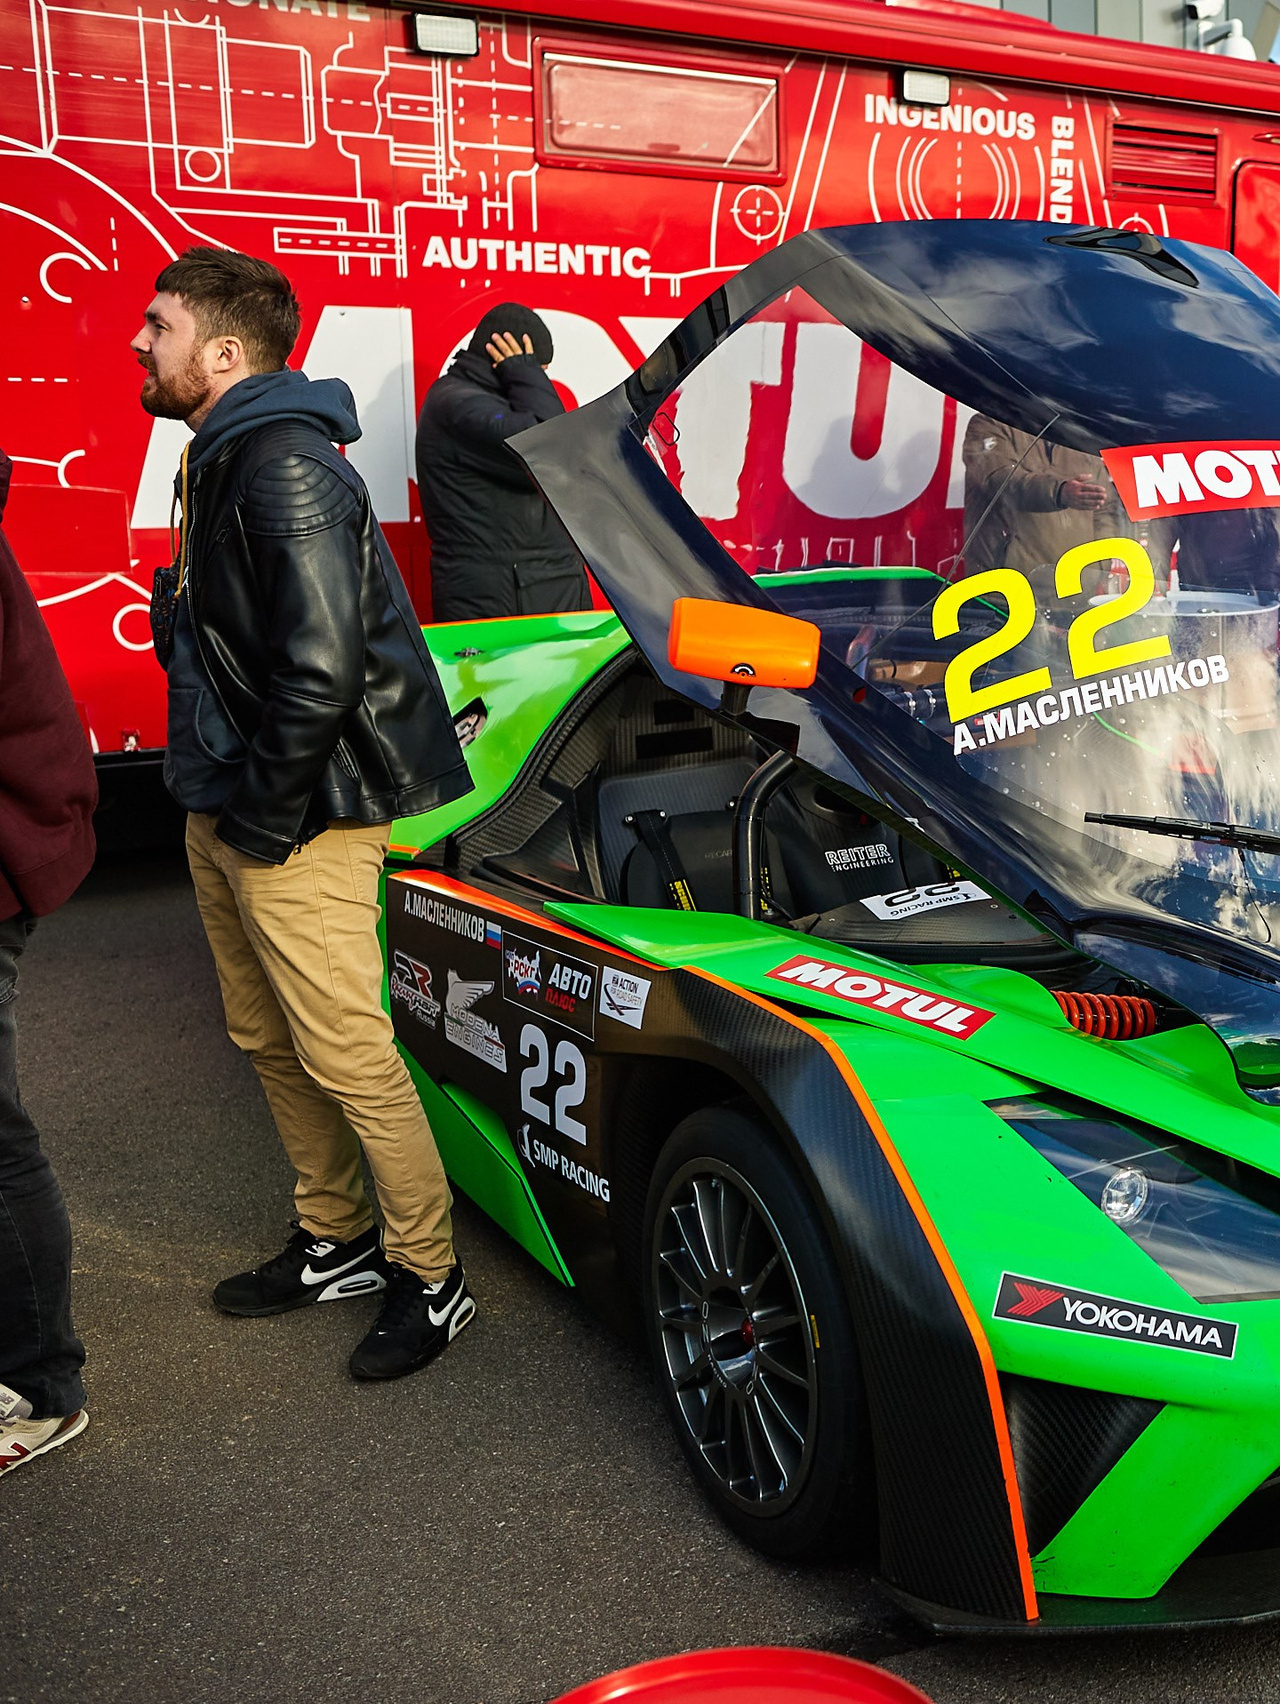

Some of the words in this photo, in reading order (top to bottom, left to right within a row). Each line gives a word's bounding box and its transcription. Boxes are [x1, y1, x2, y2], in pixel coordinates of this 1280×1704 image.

[865, 94, 1036, 140] INGENIOUS
[1050, 116, 1075, 223] BLEND
[422, 236, 651, 278] AUTHENTIC
[932, 537, 1172, 723] 22
[953, 655, 1229, 756] А.МАСЛЕННИКОВ
[825, 844, 891, 865] REITER
[404, 890, 484, 943] А.МАСЛЕННИКОВ
[890, 900, 934, 916] RACING
[545, 987, 576, 1013] ПЛЮС
[548, 963, 592, 1000] АВТО
[619, 978, 640, 994] ACTION
[777, 962, 974, 1033] MOTUL
[446, 1021, 504, 1064] ENGINES
[450, 1002, 499, 1041] MODENA
[520, 1023, 586, 1146] 22
[533, 1139, 559, 1170] SMP
[561, 1155, 610, 1202] RACING
[1063, 1296, 1223, 1348] YOKOHAMA
